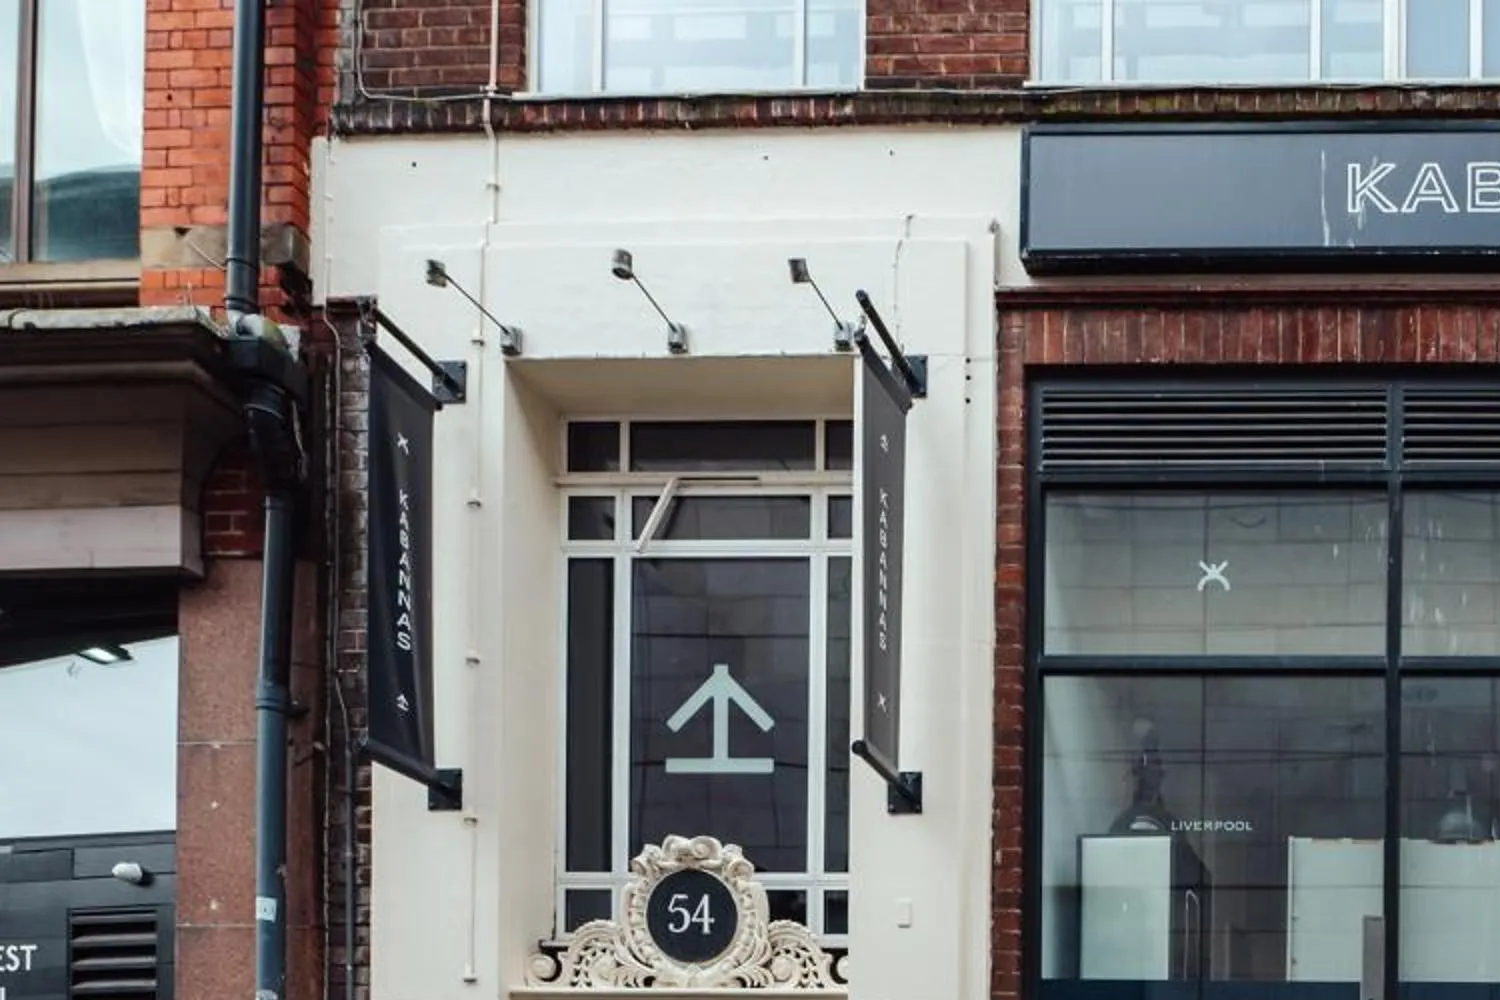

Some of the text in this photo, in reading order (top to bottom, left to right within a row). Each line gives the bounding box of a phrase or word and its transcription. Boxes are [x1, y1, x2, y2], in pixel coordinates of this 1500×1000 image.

[397, 488, 412, 651] KABANNAS
[878, 487, 889, 651] KABANNAS
[1170, 819, 1254, 832] LIVERPOOL
[667, 892, 716, 935] 54
